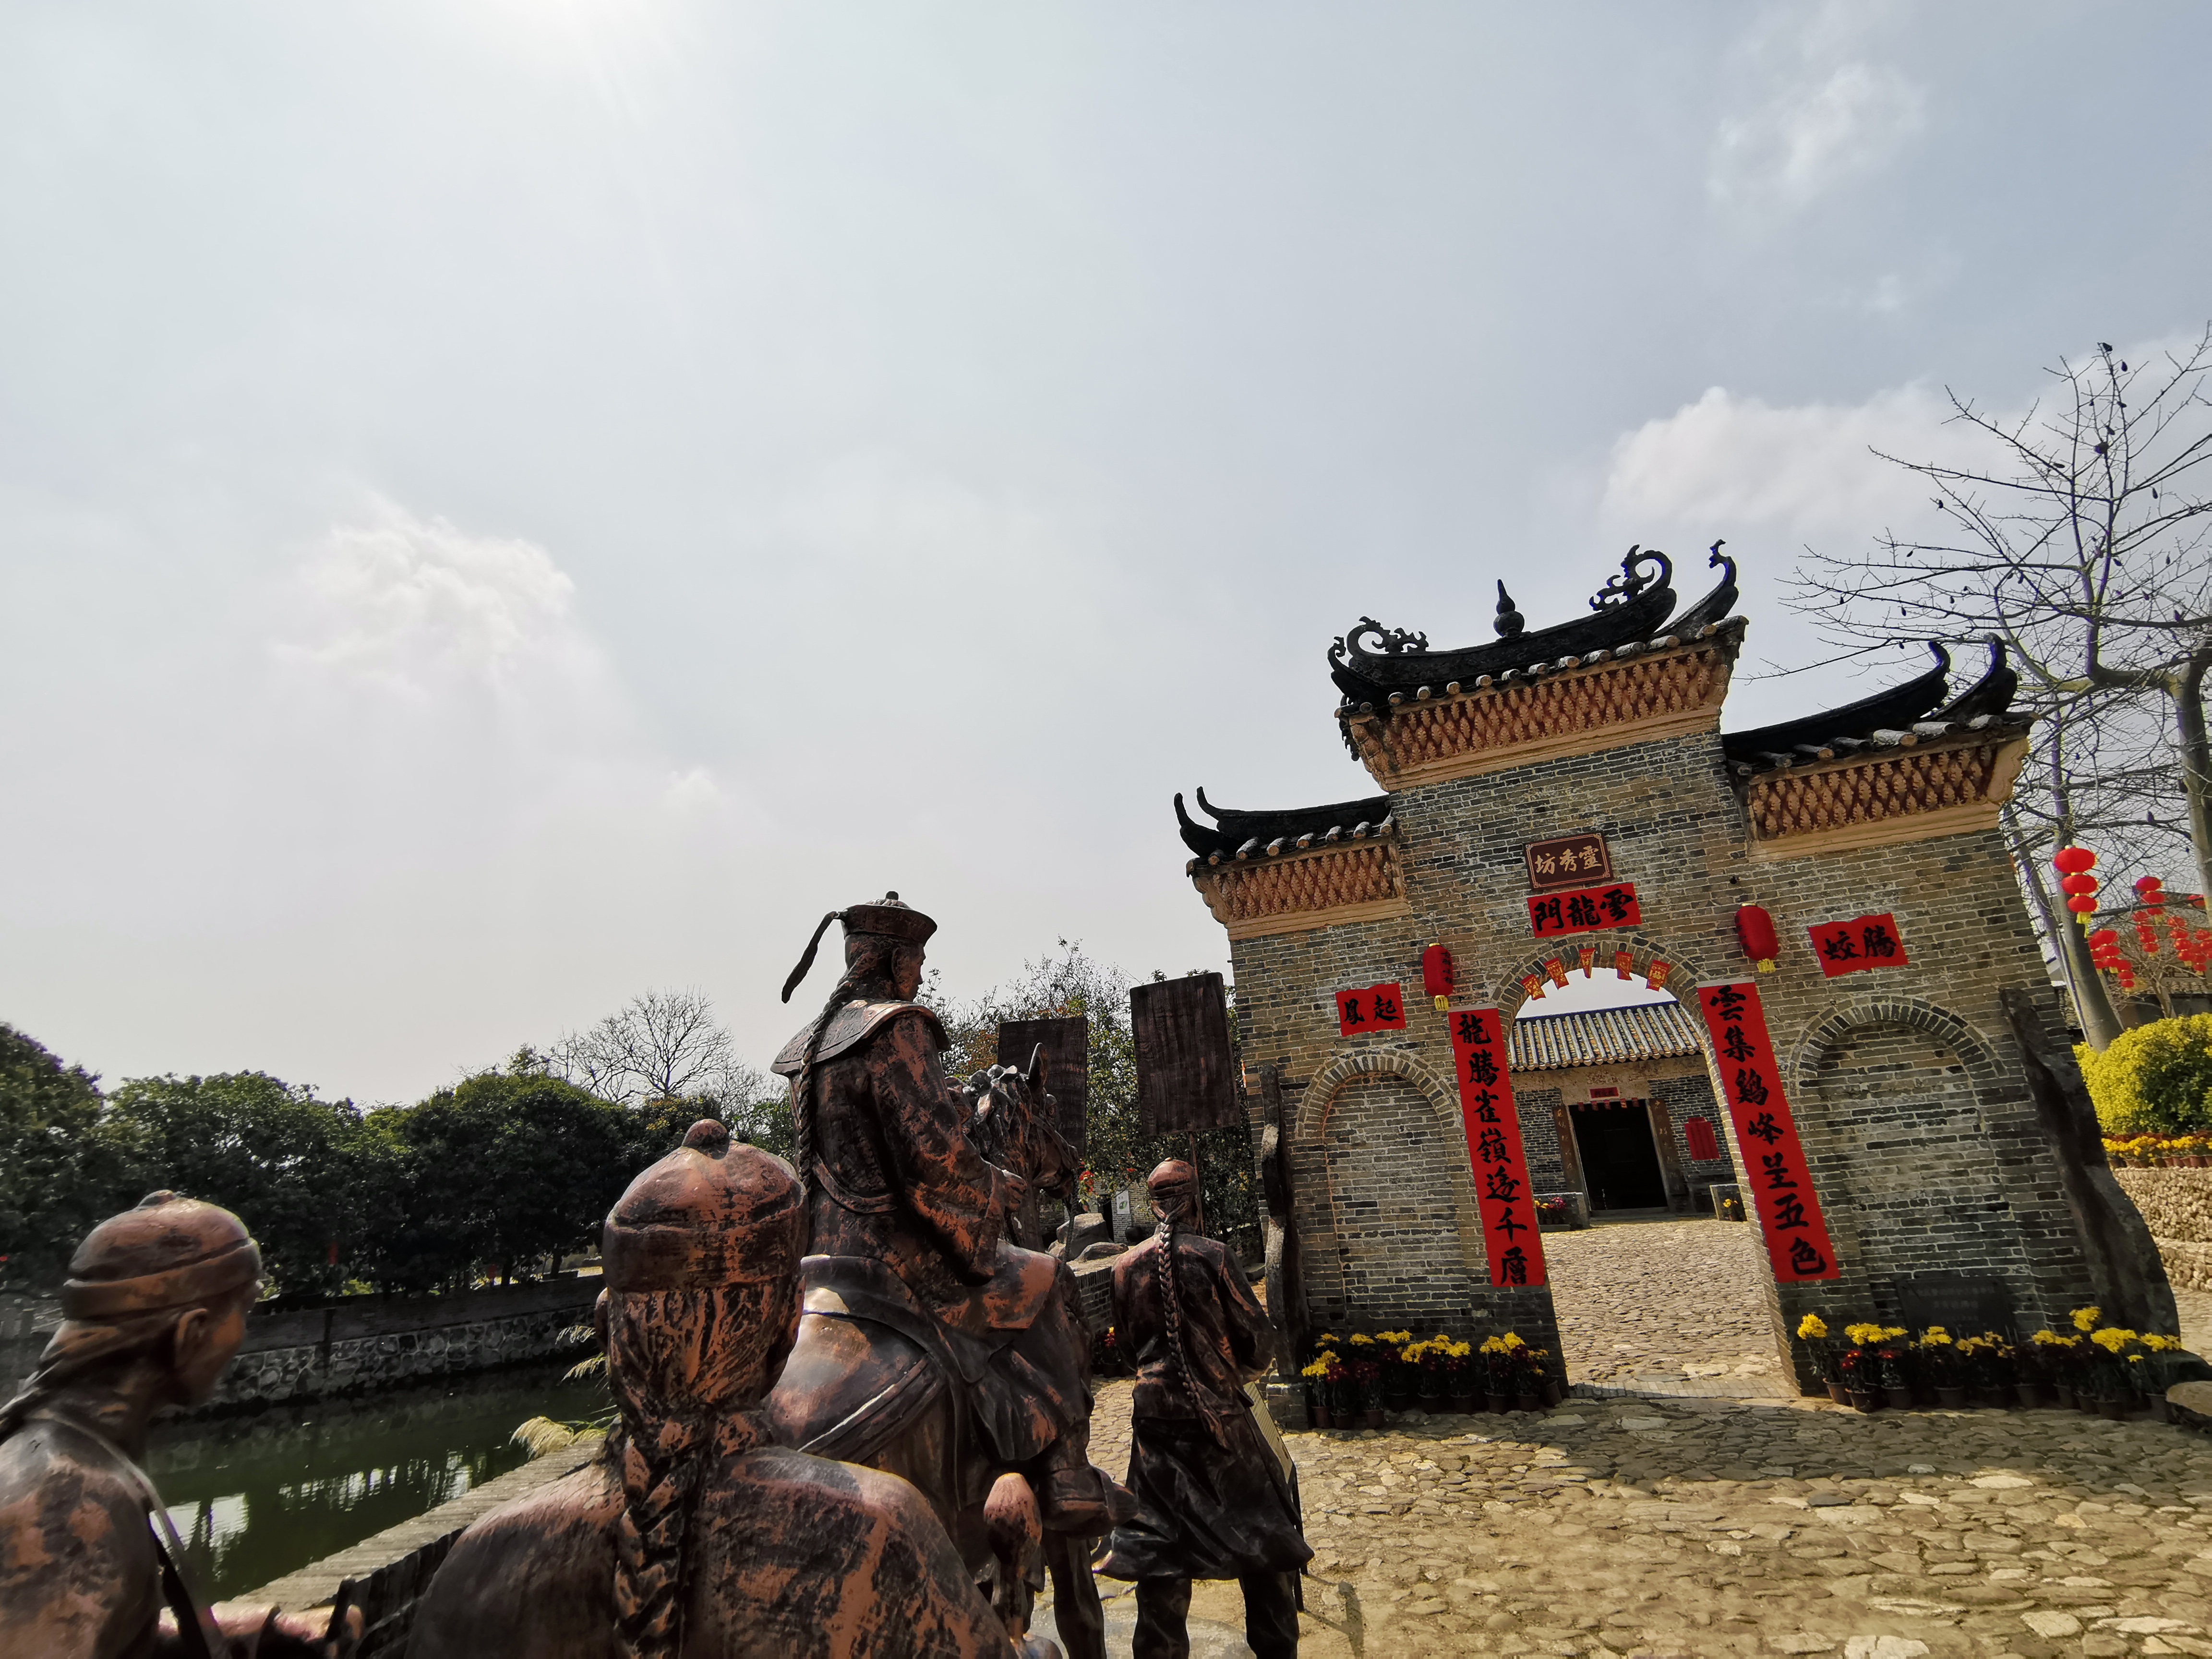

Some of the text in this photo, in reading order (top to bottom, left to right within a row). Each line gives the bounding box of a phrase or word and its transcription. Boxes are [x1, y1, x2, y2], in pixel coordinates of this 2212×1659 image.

[1533, 888, 1634, 931] 雲龍門
[1823, 925, 1897, 961] 騰蛟
[1344, 994, 1400, 1025] 起鳳
